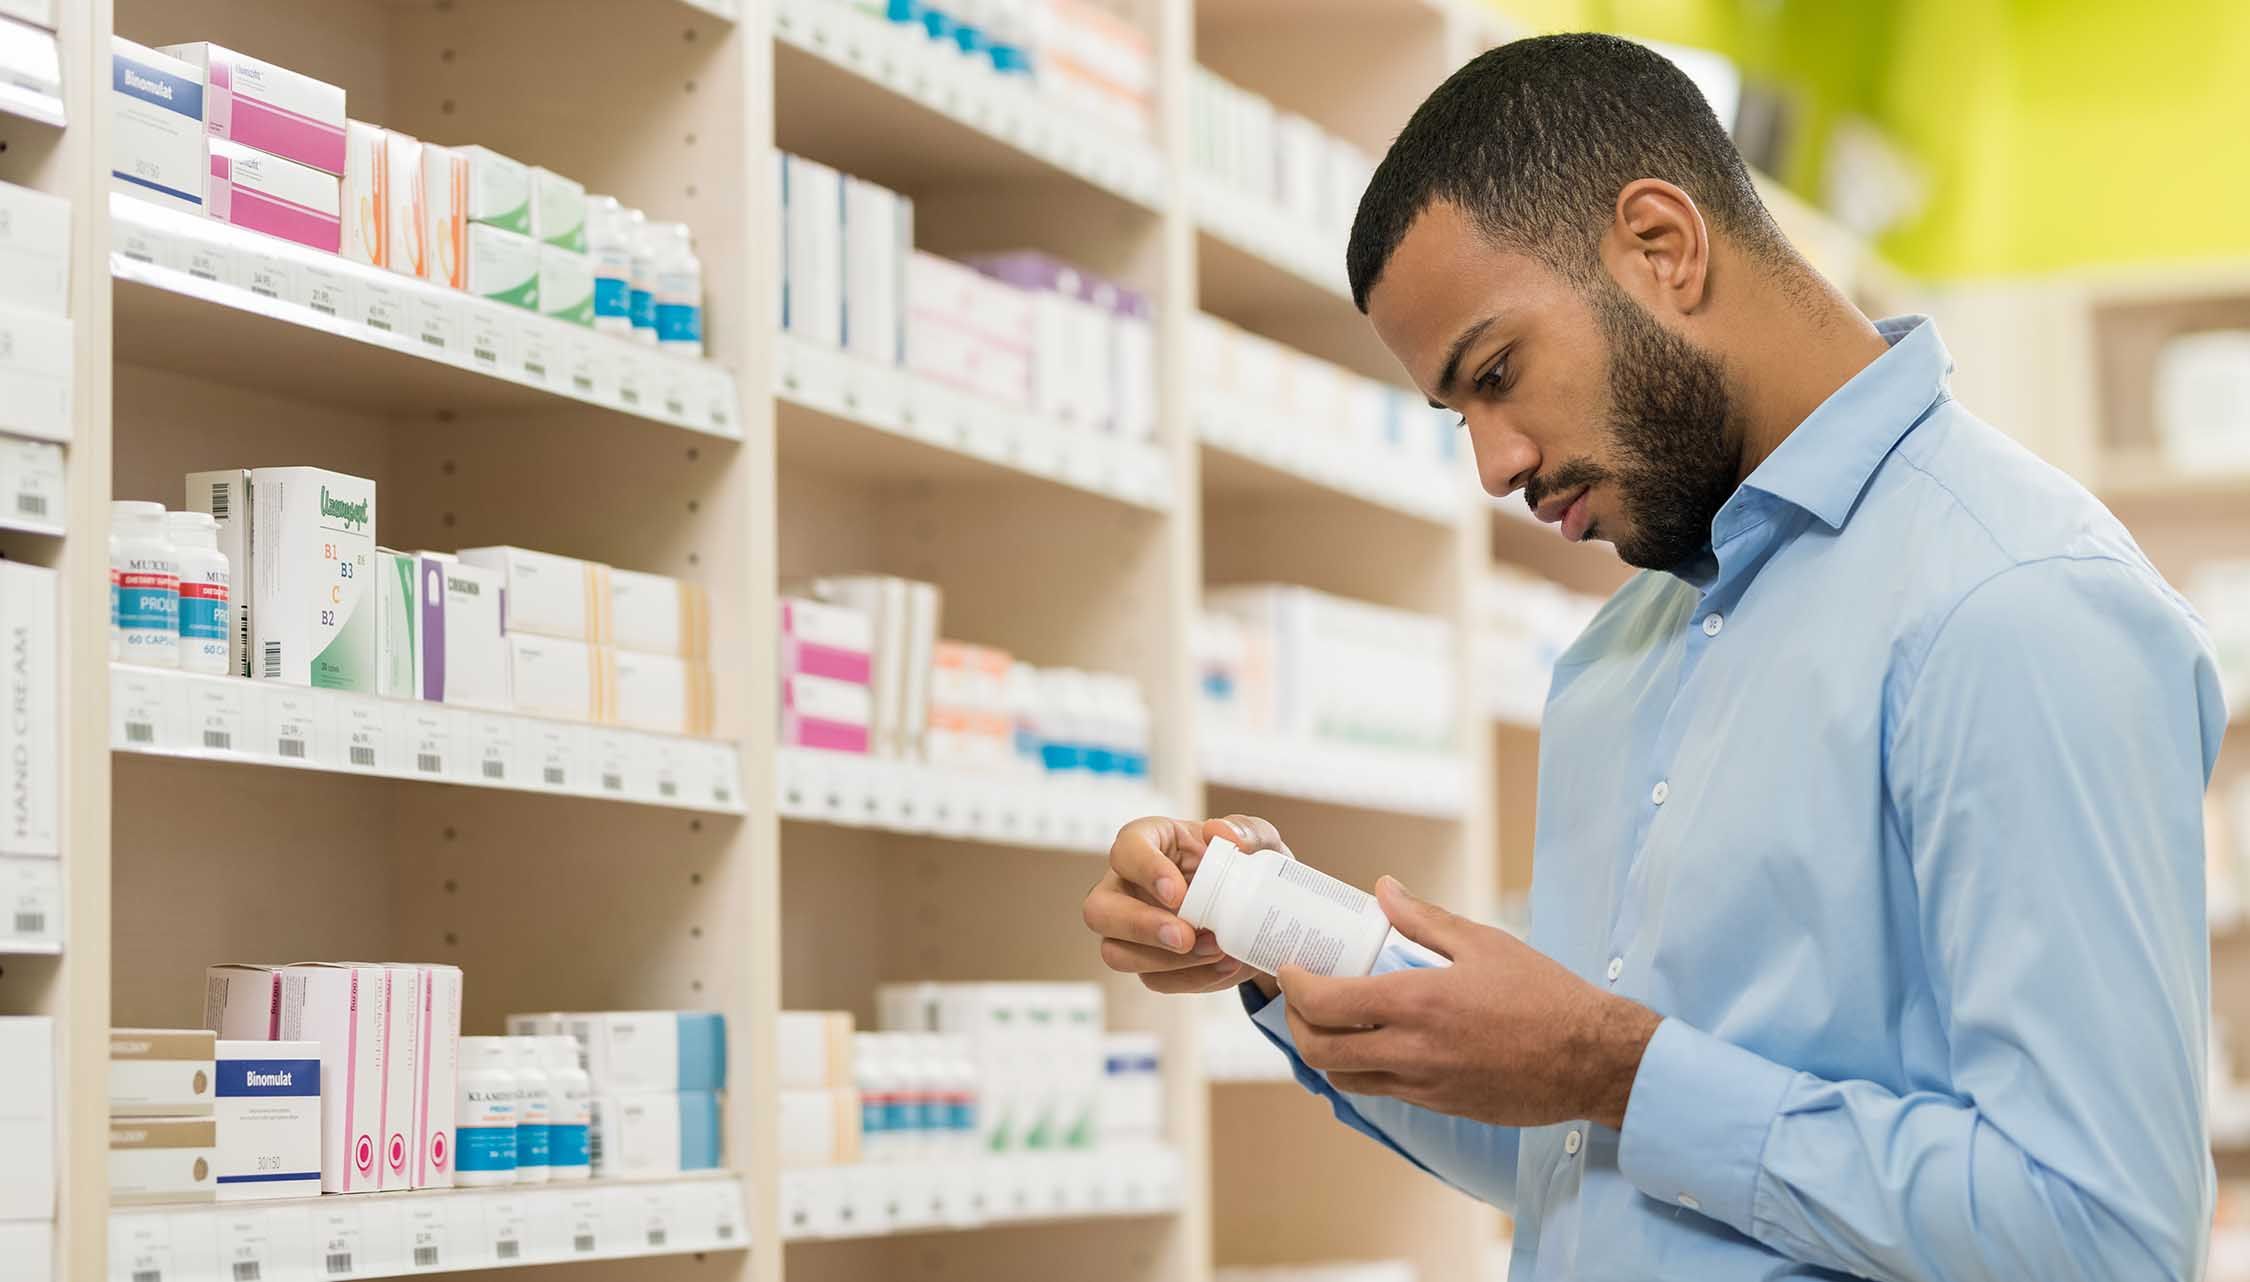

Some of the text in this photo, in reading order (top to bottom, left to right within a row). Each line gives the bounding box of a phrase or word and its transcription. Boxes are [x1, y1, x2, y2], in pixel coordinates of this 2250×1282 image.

[124, 68, 173, 100] Binomulat
[324, 543, 337, 560] B1
[341, 562, 353, 578] B3
[332, 585, 341, 603] C
[321, 610, 335, 626] B2
[13, 626, 28, 839] HAND CREAM
[350, 996, 357, 1012] mg
[246, 1071, 292, 1087] Binomulat
